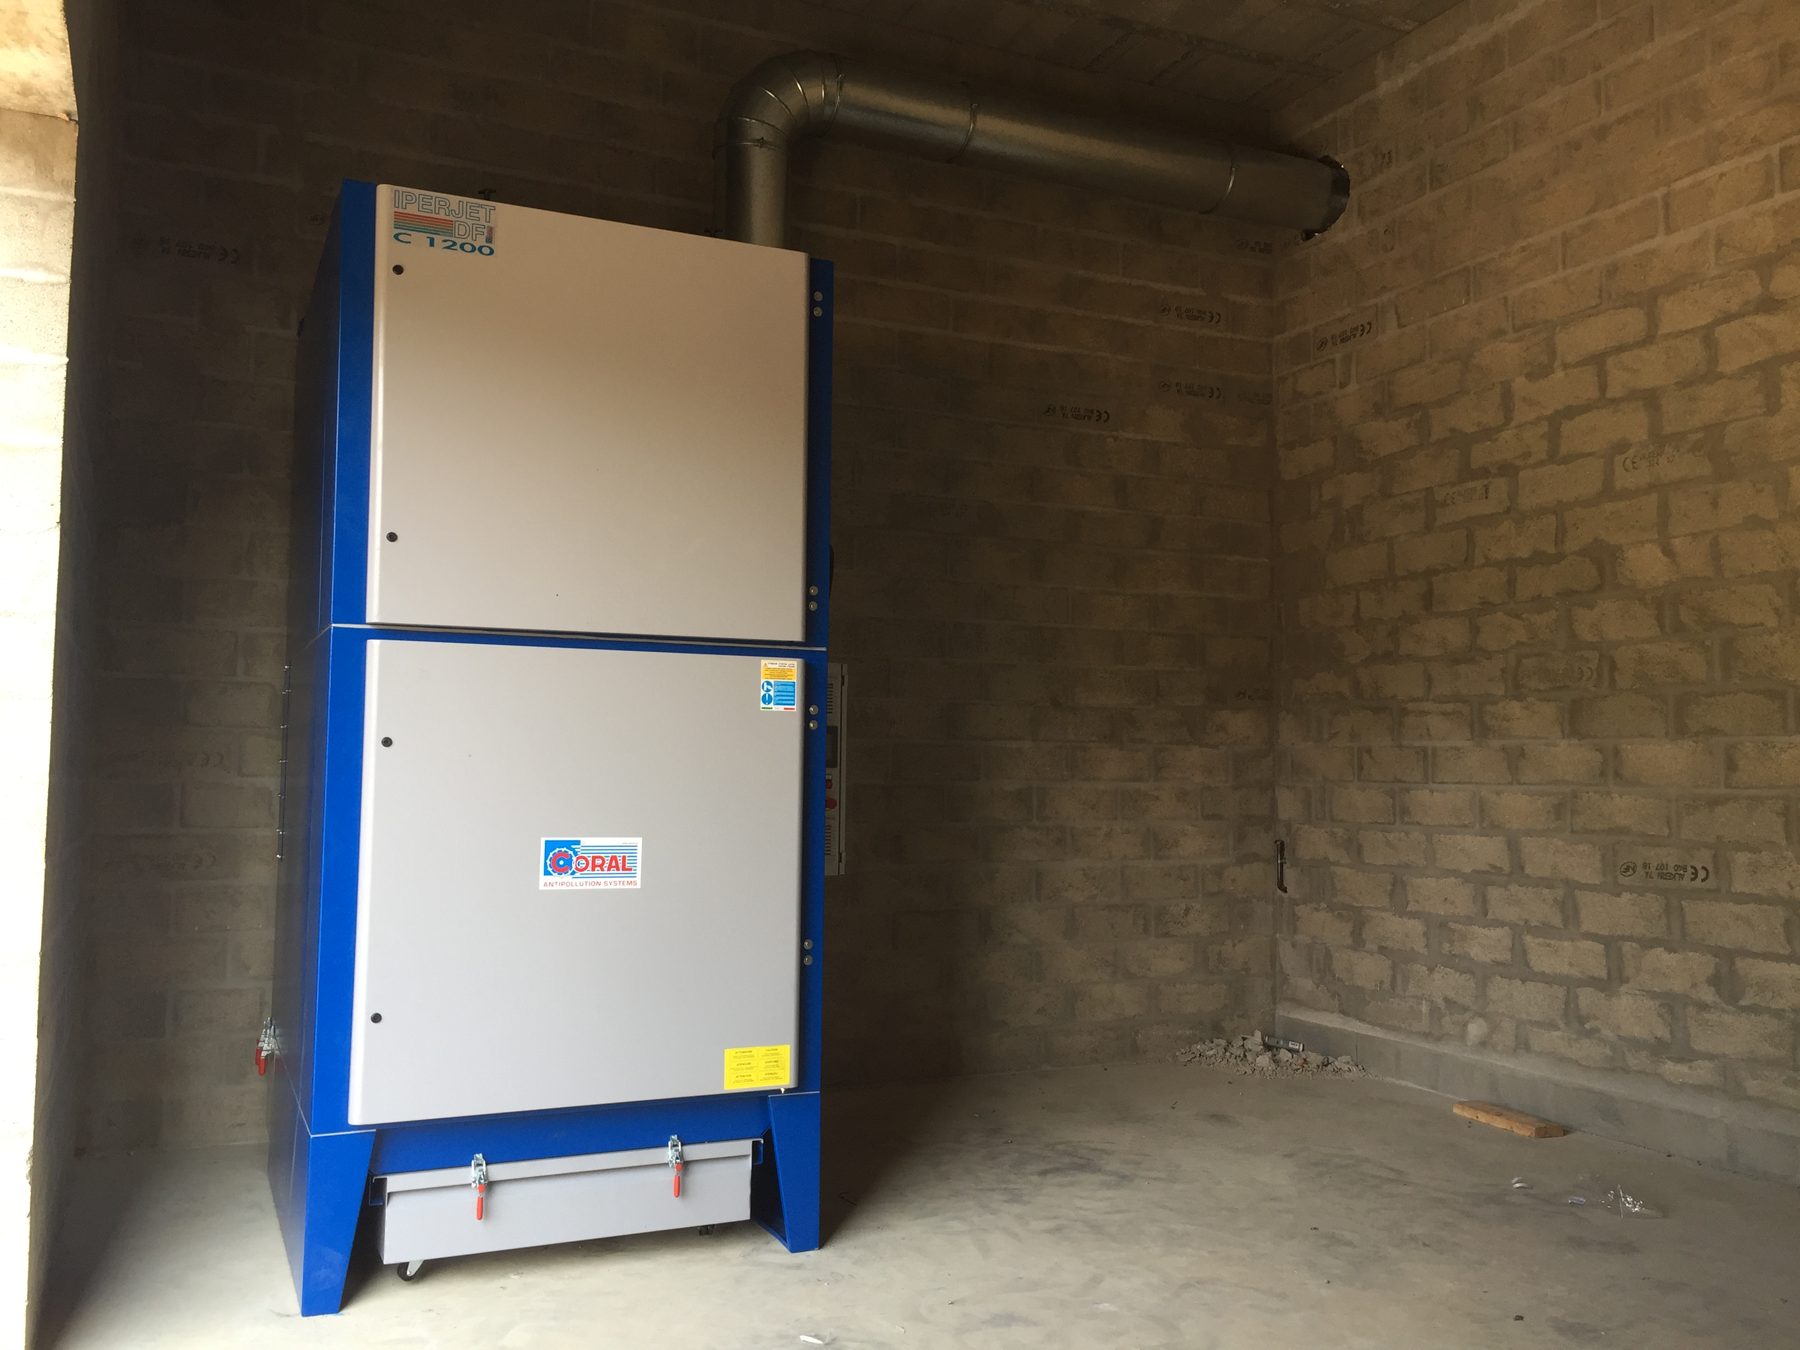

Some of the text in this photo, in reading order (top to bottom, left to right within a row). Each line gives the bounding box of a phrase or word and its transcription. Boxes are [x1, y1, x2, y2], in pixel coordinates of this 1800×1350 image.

[394, 189, 496, 223] IPERJET
[393, 232, 494, 256] C 1200
[1096, 409, 1110, 423] CE
[551, 852, 633, 873] CORAL
[1655, 863, 1669, 871] 107
[1690, 865, 1710, 883] CE
